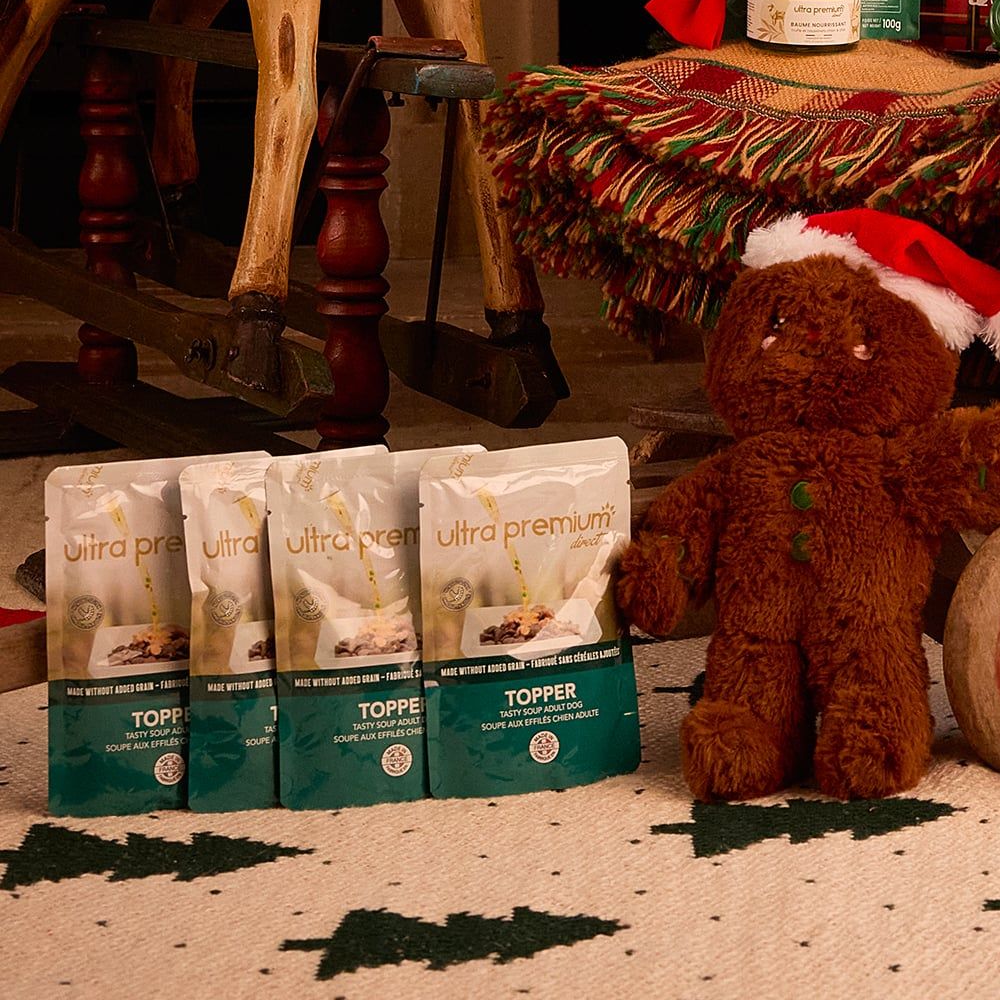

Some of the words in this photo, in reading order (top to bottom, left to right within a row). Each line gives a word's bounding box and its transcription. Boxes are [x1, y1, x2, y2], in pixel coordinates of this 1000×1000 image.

[794, 4, 812, 13] ultra
[814, 6, 844, 16] premium
[882, 19, 901, 32] 100g
[437, 519, 496, 547] ultra
[504, 510, 610, 549] premium
[64, 531, 126, 562] ultra
[203, 530, 259, 559] ultra
[286, 526, 350, 554] ultra
[359, 526, 420, 560] prem
[570, 532, 608, 550] direct
[440, 667, 458, 677] MADE
[459, 665, 486, 676] WITHOUT
[487, 663, 507, 674] ADDED
[507, 662, 525, 672] GRAIN
[530, 657, 558, 669] FABRIQUÉ
[558, 655, 573, 664] SANS
[573, 651, 599, 663] CÉRÉALES
[207, 683, 225, 692] MADE
[226, 681, 254, 691] WITHOUT
[255, 678, 273, 689] ADDED
[294, 678, 311, 688] MADE
[312, 676, 340, 687] WITHOUT
[341, 674, 361, 685] ADDED
[362, 673, 380, 684] GRAIN
[386, 670, 414, 681] FABRIQUÉ
[67, 687, 84, 696] MADE
[85, 686, 113, 696] WITHOUT
[115, 683, 135, 694] ADDED
[135, 681, 154, 692] GRAIN
[504, 682, 577, 707] TOPPER
[500, 709, 522, 718] TASTY
[523, 706, 542, 716] SOUP
[543, 703, 566, 713] ADULT
[566, 701, 583, 710] DOG
[352, 722, 375, 731] TASTY
[376, 719, 396, 729] SOUP
[397, 717, 420, 727] ADULT
[481, 721, 507, 732] SOUPE
[508, 719, 524, 729] AUX
[524, 715, 552, 727] EFFILÉS
[552, 712, 575, 723] CHIEN
[575, 708, 600, 720] ADULTE
[125, 731, 148, 740] TASTY
[149, 729, 171, 738] SOUP
[245, 737, 270, 747] SOUPE
[333, 734, 359, 744] SOUPE
[360, 733, 377, 741] AUX
[377, 729, 406, 740] EFFILÉS
[105, 743, 132, 752] SOUPE
[133, 741, 150, 750] AUX
[150, 737, 180, 748] EFFILÉS
